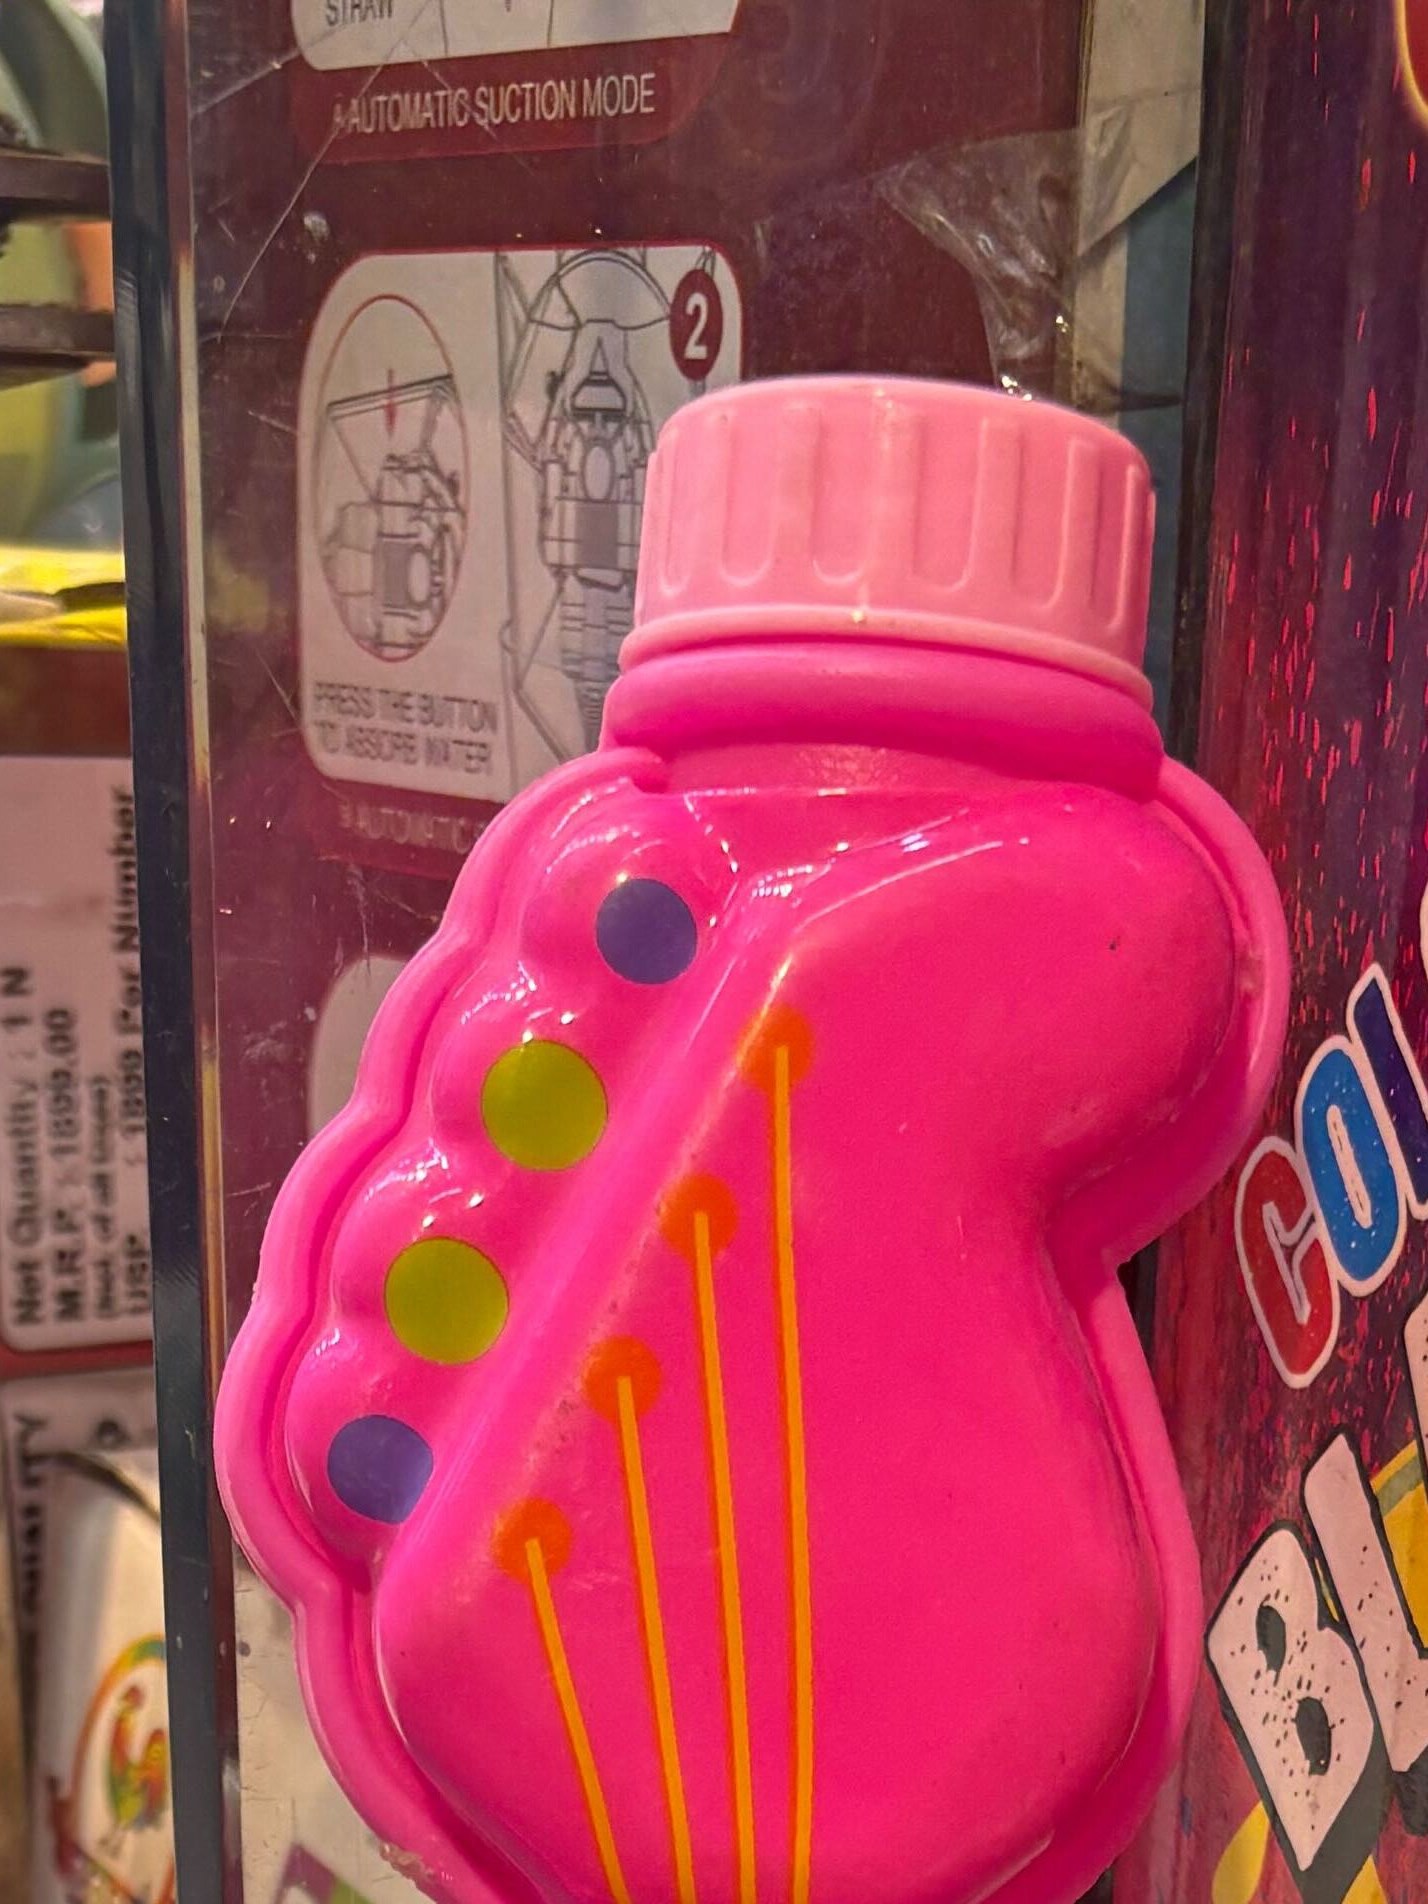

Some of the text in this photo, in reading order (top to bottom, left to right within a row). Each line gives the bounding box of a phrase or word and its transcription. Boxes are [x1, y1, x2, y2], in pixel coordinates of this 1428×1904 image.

[475, 80, 576, 127] SUCTION
[582, 73, 656, 117] MODE
[684, 291, 710, 362] 2
